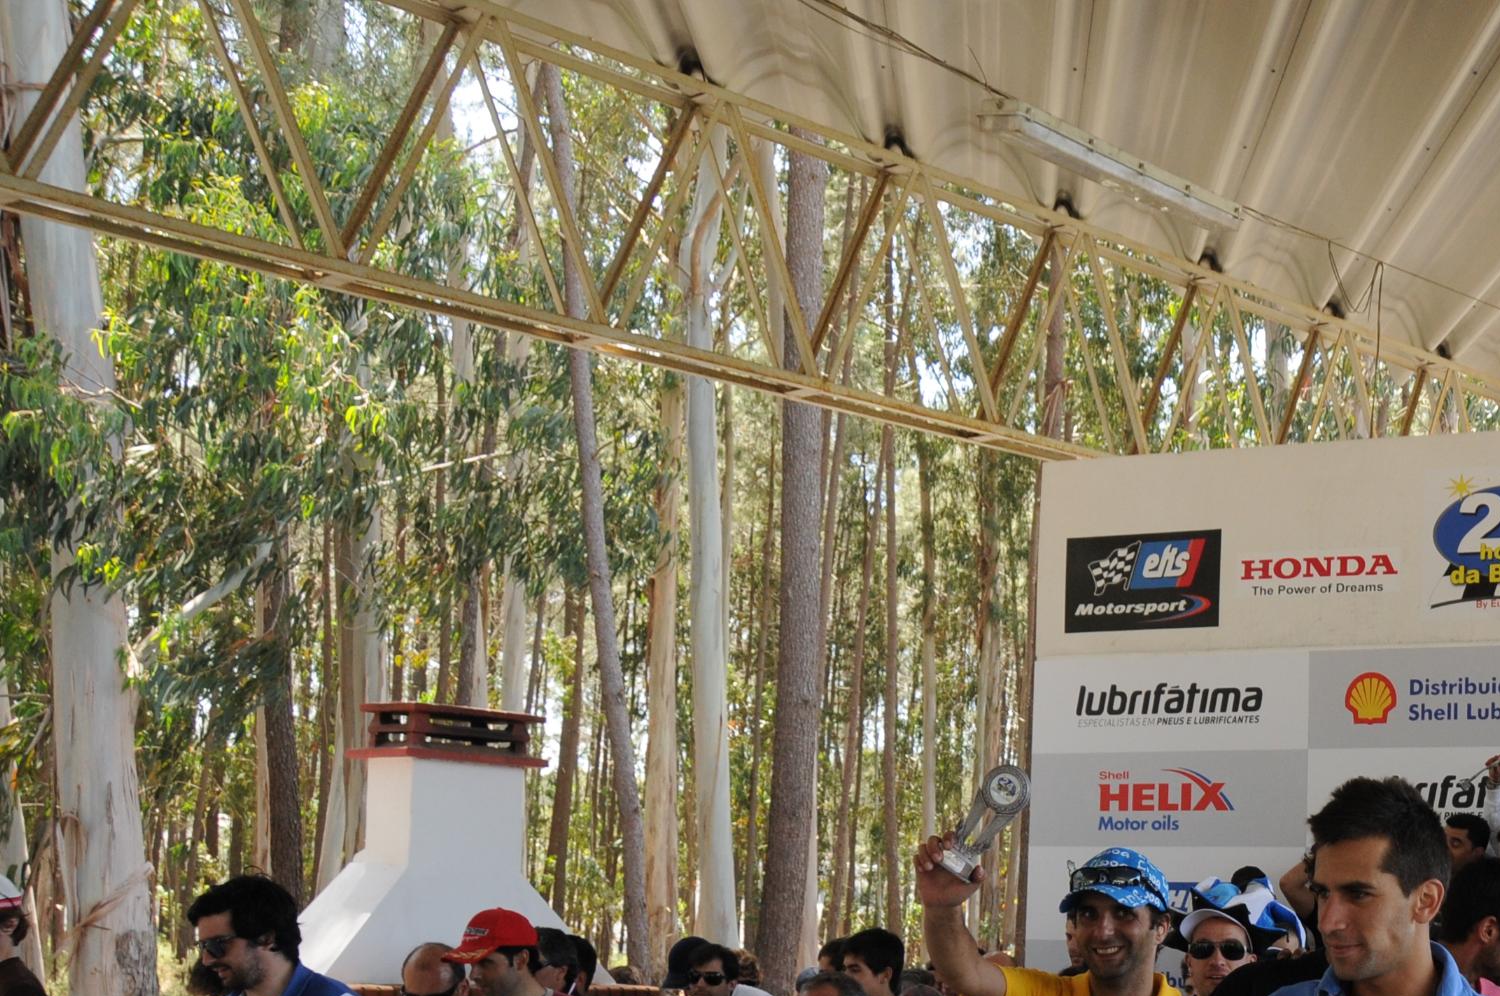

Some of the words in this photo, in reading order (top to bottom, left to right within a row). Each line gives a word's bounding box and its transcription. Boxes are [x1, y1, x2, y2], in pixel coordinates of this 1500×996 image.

[1241, 554, 1398, 580] HONDA
[1451, 565, 1480, 585] da
[1252, 586, 1274, 596] The
[1278, 584, 1316, 595] Power
[1320, 583, 1332, 593] of
[1336, 582, 1384, 593] Dreams
[1075, 600, 1187, 616] Motorsport
[1476, 600, 1488, 609] By
[1076, 683, 1263, 716] lubrifátima
[1409, 702, 1458, 721] Shell
[1078, 718, 1140, 728] ESPECIALISTAS
[1142, 717, 1156, 727] EM
[1156, 717, 1184, 726] PNEUS
[1194, 715, 1260, 725] LUBRIFICANTES
[1099, 771, 1129, 780] Shell
[1099, 782, 1229, 811] HELIX
[1098, 816, 1148, 831] Motor
[1151, 815, 1179, 831] oils
